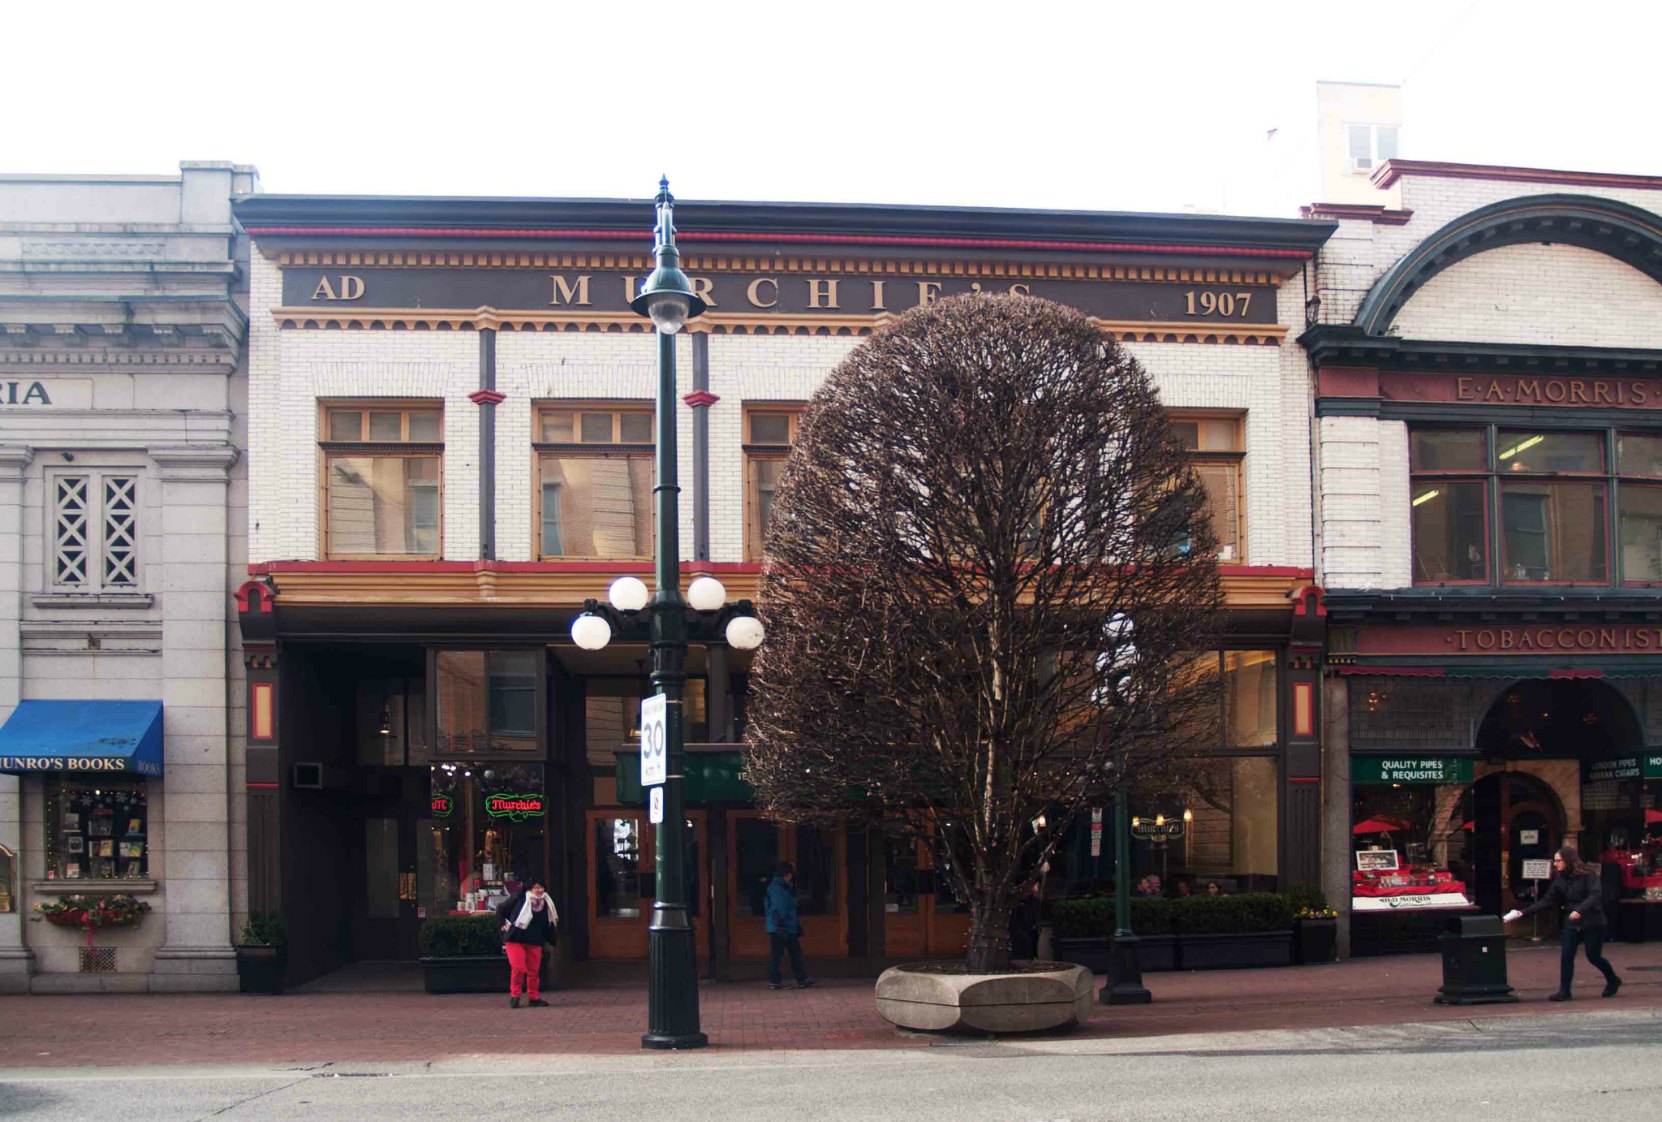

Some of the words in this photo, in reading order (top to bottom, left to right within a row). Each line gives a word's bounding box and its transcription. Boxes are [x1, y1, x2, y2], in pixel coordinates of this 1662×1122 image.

[311, 275, 365, 300] AD
[1184, 291, 1251, 317] 1907
[0, 381, 52, 405] IA
[644, 720, 663, 759] 30
[0, 757, 63, 770] UNRO'S
[68, 757, 125, 770] BOOKS
[138, 760, 160, 774] BOOKS
[1381, 760, 1417, 770] QUALITY
[1420, 760, 1443, 769] PIPES
[1618, 758, 1636, 768] PIPES
[1381, 770, 1389, 780] &
[1392, 770, 1444, 780] REQUISITES
[1615, 768, 1640, 778] CIGARS
[492, 799, 541, 811] Murchie's
